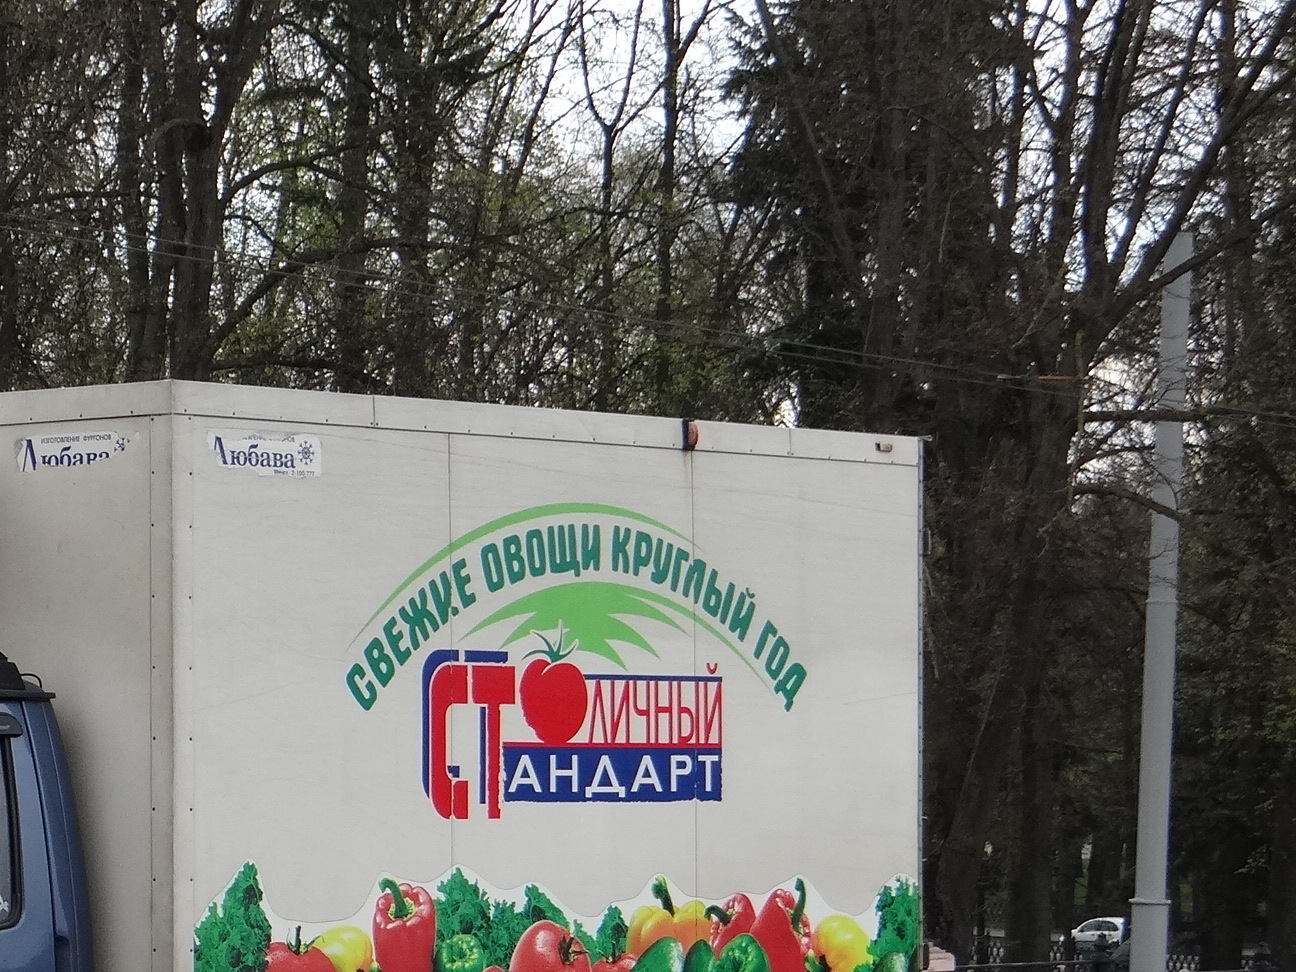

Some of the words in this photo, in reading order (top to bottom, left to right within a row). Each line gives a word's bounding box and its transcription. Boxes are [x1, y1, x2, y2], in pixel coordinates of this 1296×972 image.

[83, 433, 112, 442] ФУРГОНОВ
[214, 435, 296, 469] Любава
[345, 557, 477, 712] СВЕЖИЕ
[479, 522, 601, 594] ОВОЩИ
[611, 524, 756, 643] КРУГЛЫЙ
[752, 618, 808, 713] ГОД
